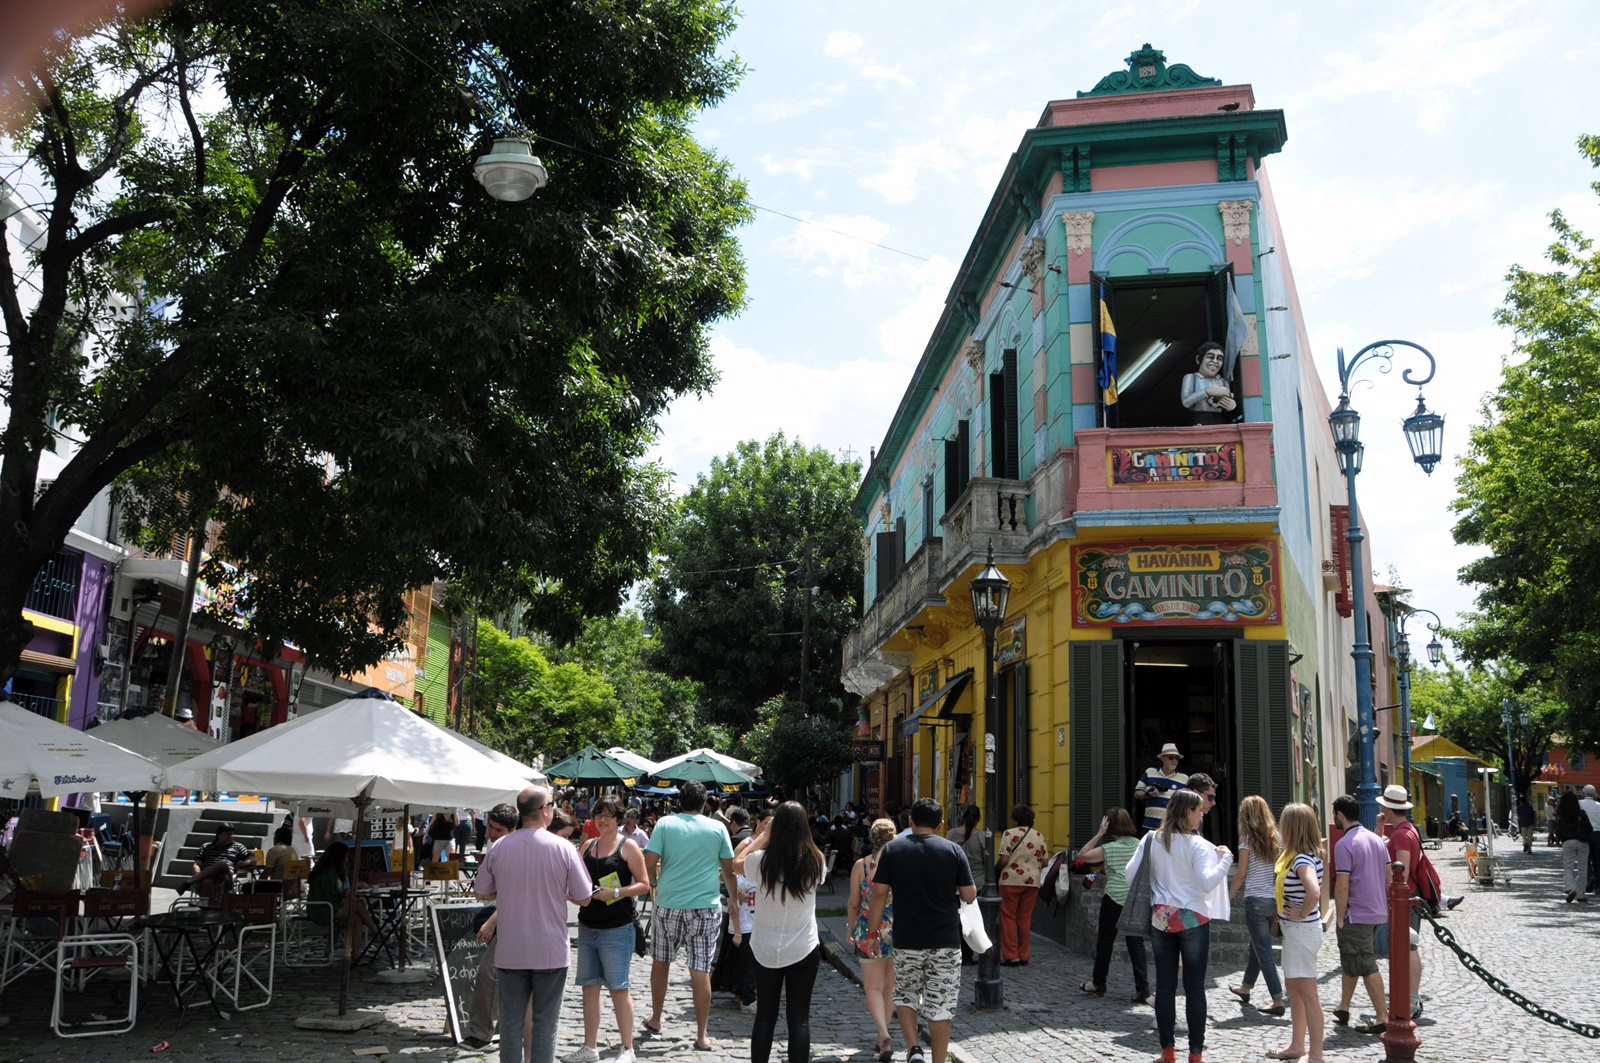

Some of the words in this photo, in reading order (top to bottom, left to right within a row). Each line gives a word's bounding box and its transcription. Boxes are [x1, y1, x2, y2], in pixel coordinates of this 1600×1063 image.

[1139, 66, 1156, 78] 1891
[1133, 452, 1219, 468] CAMINITO
[1149, 467, 1203, 477] AMIGO
[1136, 553, 1214, 569] HAVANNA
[1104, 569, 1248, 600] CAMINITO
[1154, 602, 1181, 613] DESDE
[1182, 602, 1199, 612] 1948
[54, 775, 97, 786] Filiberto
